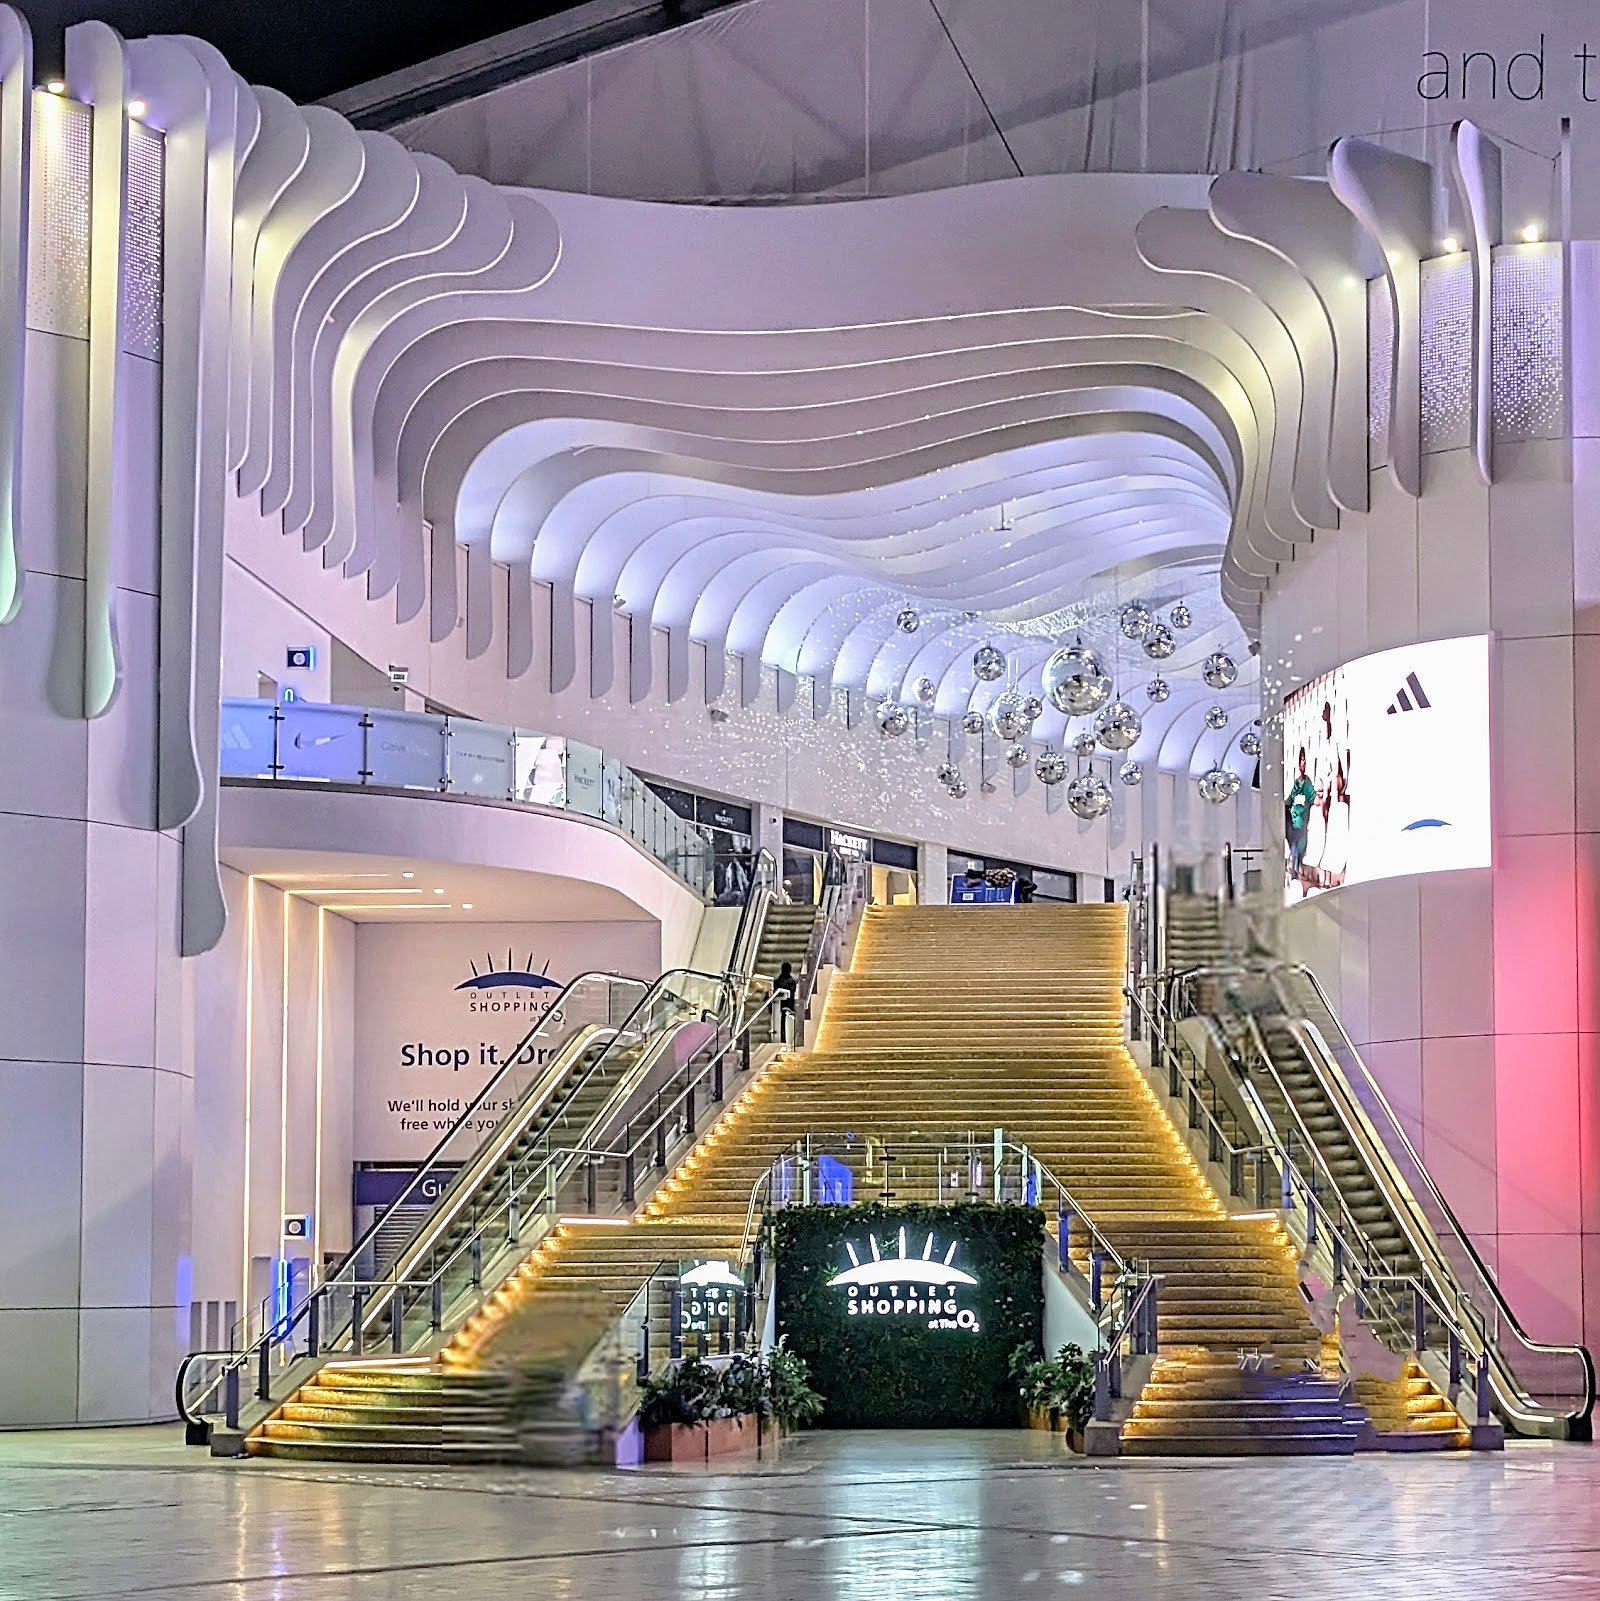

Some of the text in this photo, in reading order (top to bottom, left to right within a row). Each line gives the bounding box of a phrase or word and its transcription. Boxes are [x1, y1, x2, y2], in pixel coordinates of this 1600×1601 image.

[1417, 33, 1544, 101] and
[830, 829, 868, 851] HACKETT
[470, 991, 549, 999] OUTLET
[470, 1002, 551, 1012] SHOPPING
[401, 1043, 470, 1071] Shop
[480, 1042, 505, 1065] it.
[387, 1100, 424, 1112] We'll
[428, 1098, 460, 1112] hold
[400, 1117, 429, 1130] free
[847, 1285, 957, 1298] OUTLET
[847, 1299, 958, 1316] SHOPPING
